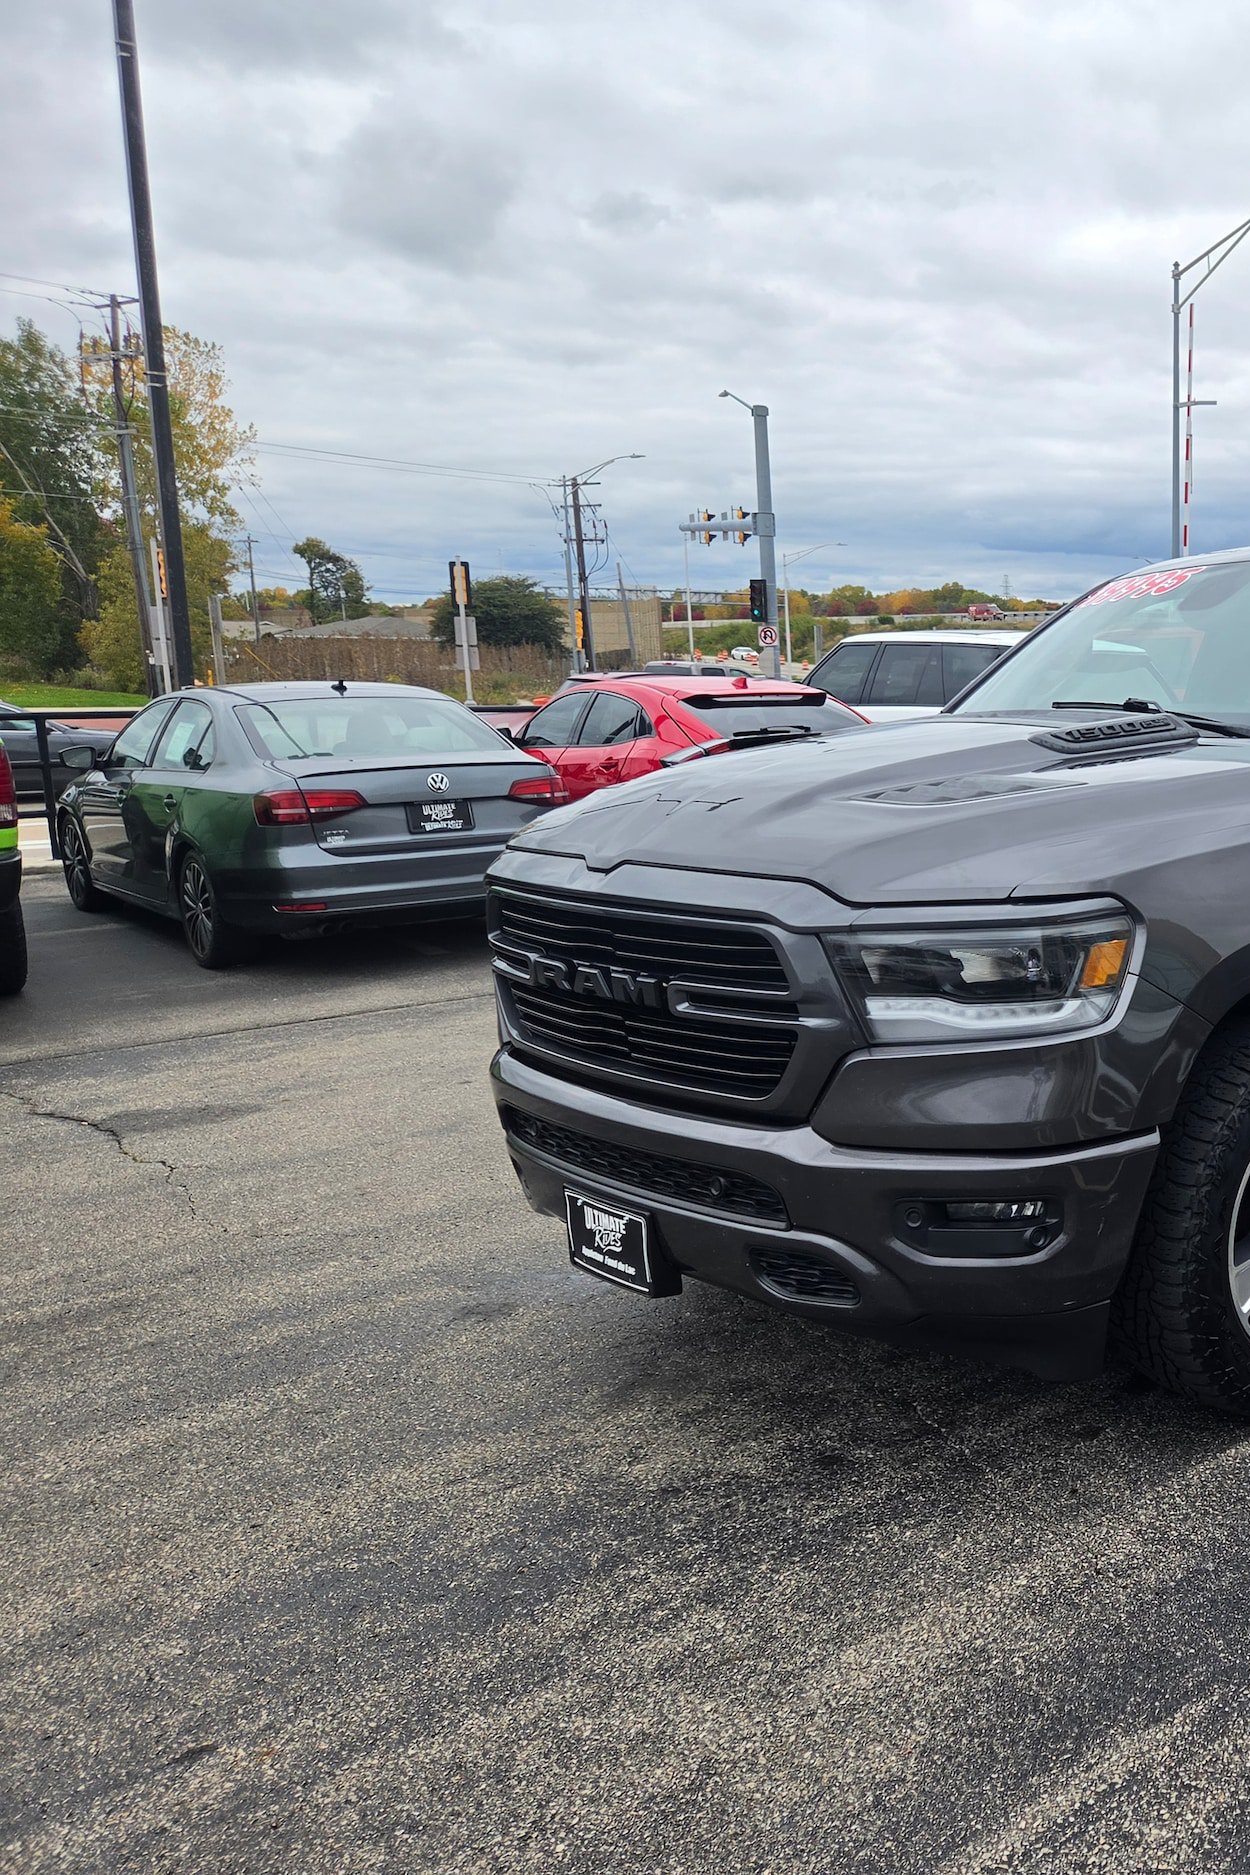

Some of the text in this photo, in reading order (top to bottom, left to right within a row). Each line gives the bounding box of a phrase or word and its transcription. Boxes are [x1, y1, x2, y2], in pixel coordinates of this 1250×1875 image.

[1064, 720, 1142, 741] 1500
[421, 803, 457, 815] ULTIMATE
[534, 956, 660, 1008] RAM
[584, 1205, 629, 1235] ULTIMATE
